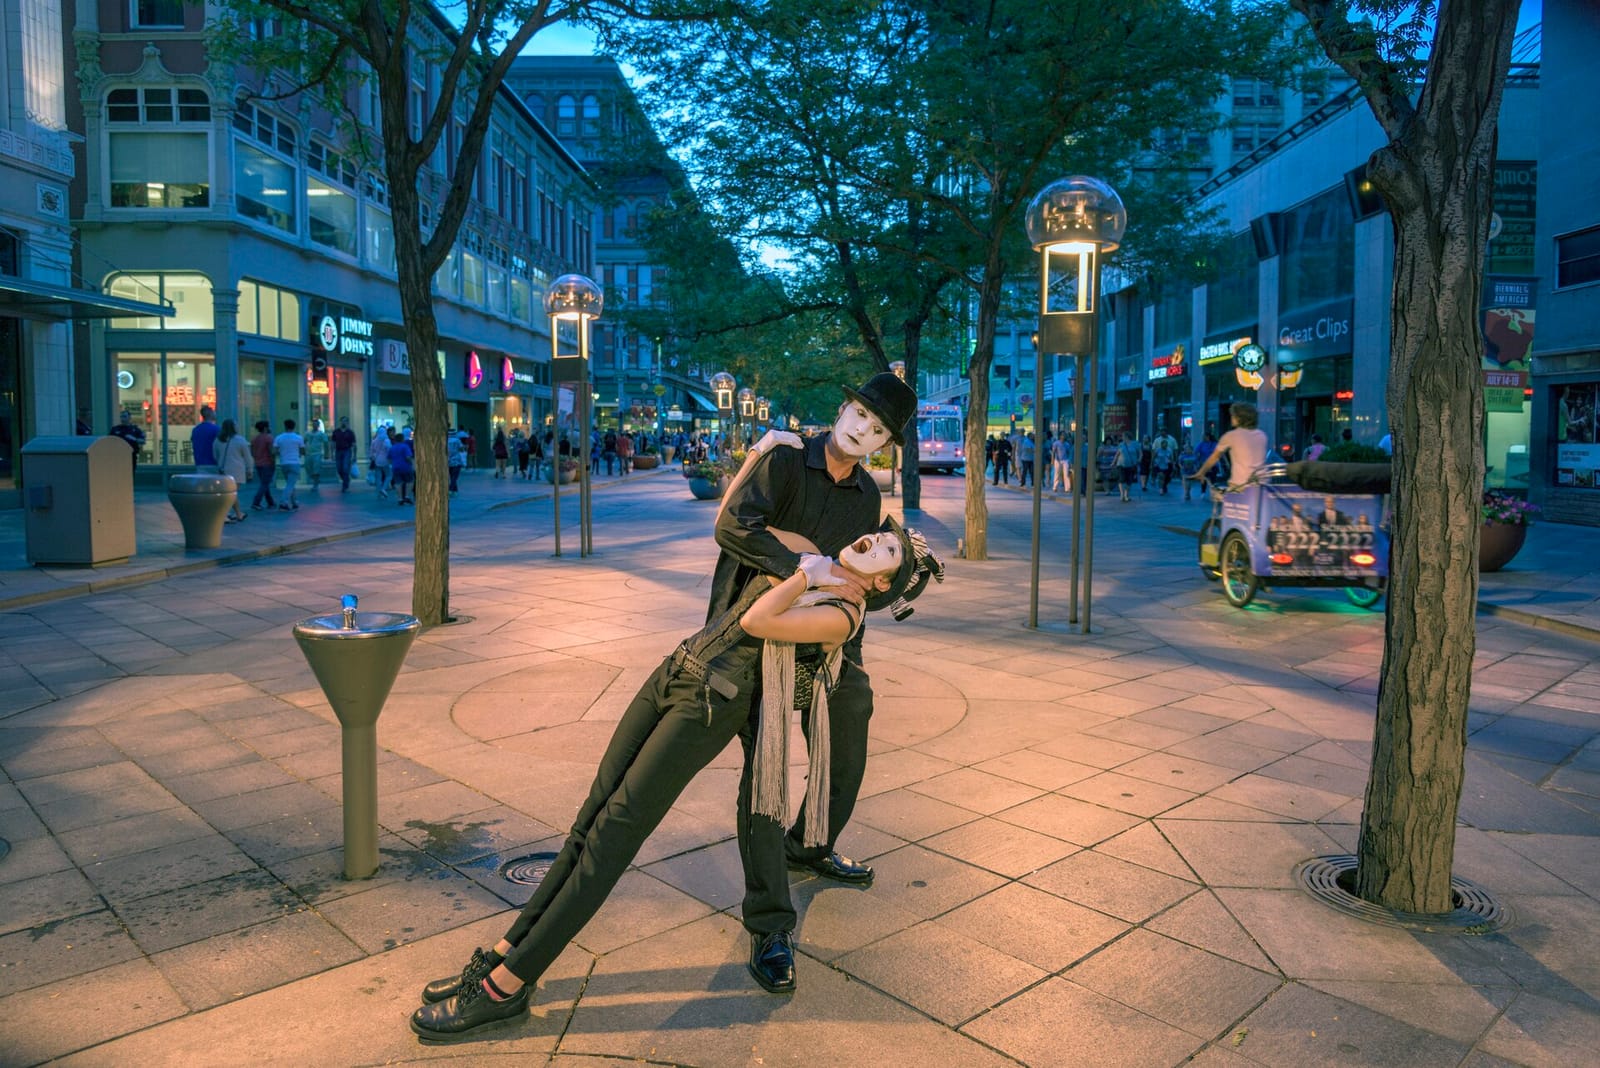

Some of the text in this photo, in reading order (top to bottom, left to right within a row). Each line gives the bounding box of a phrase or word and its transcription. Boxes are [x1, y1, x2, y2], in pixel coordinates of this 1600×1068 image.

[340, 317, 373, 336] JIMMY
[1280, 317, 1348, 345] Great Clips
[340, 337, 373, 356] JOHN'S
[1486, 375, 1501, 386] JULY
[168, 386, 193, 397] REE
[1286, 532, 1374, 549] 222-2222
